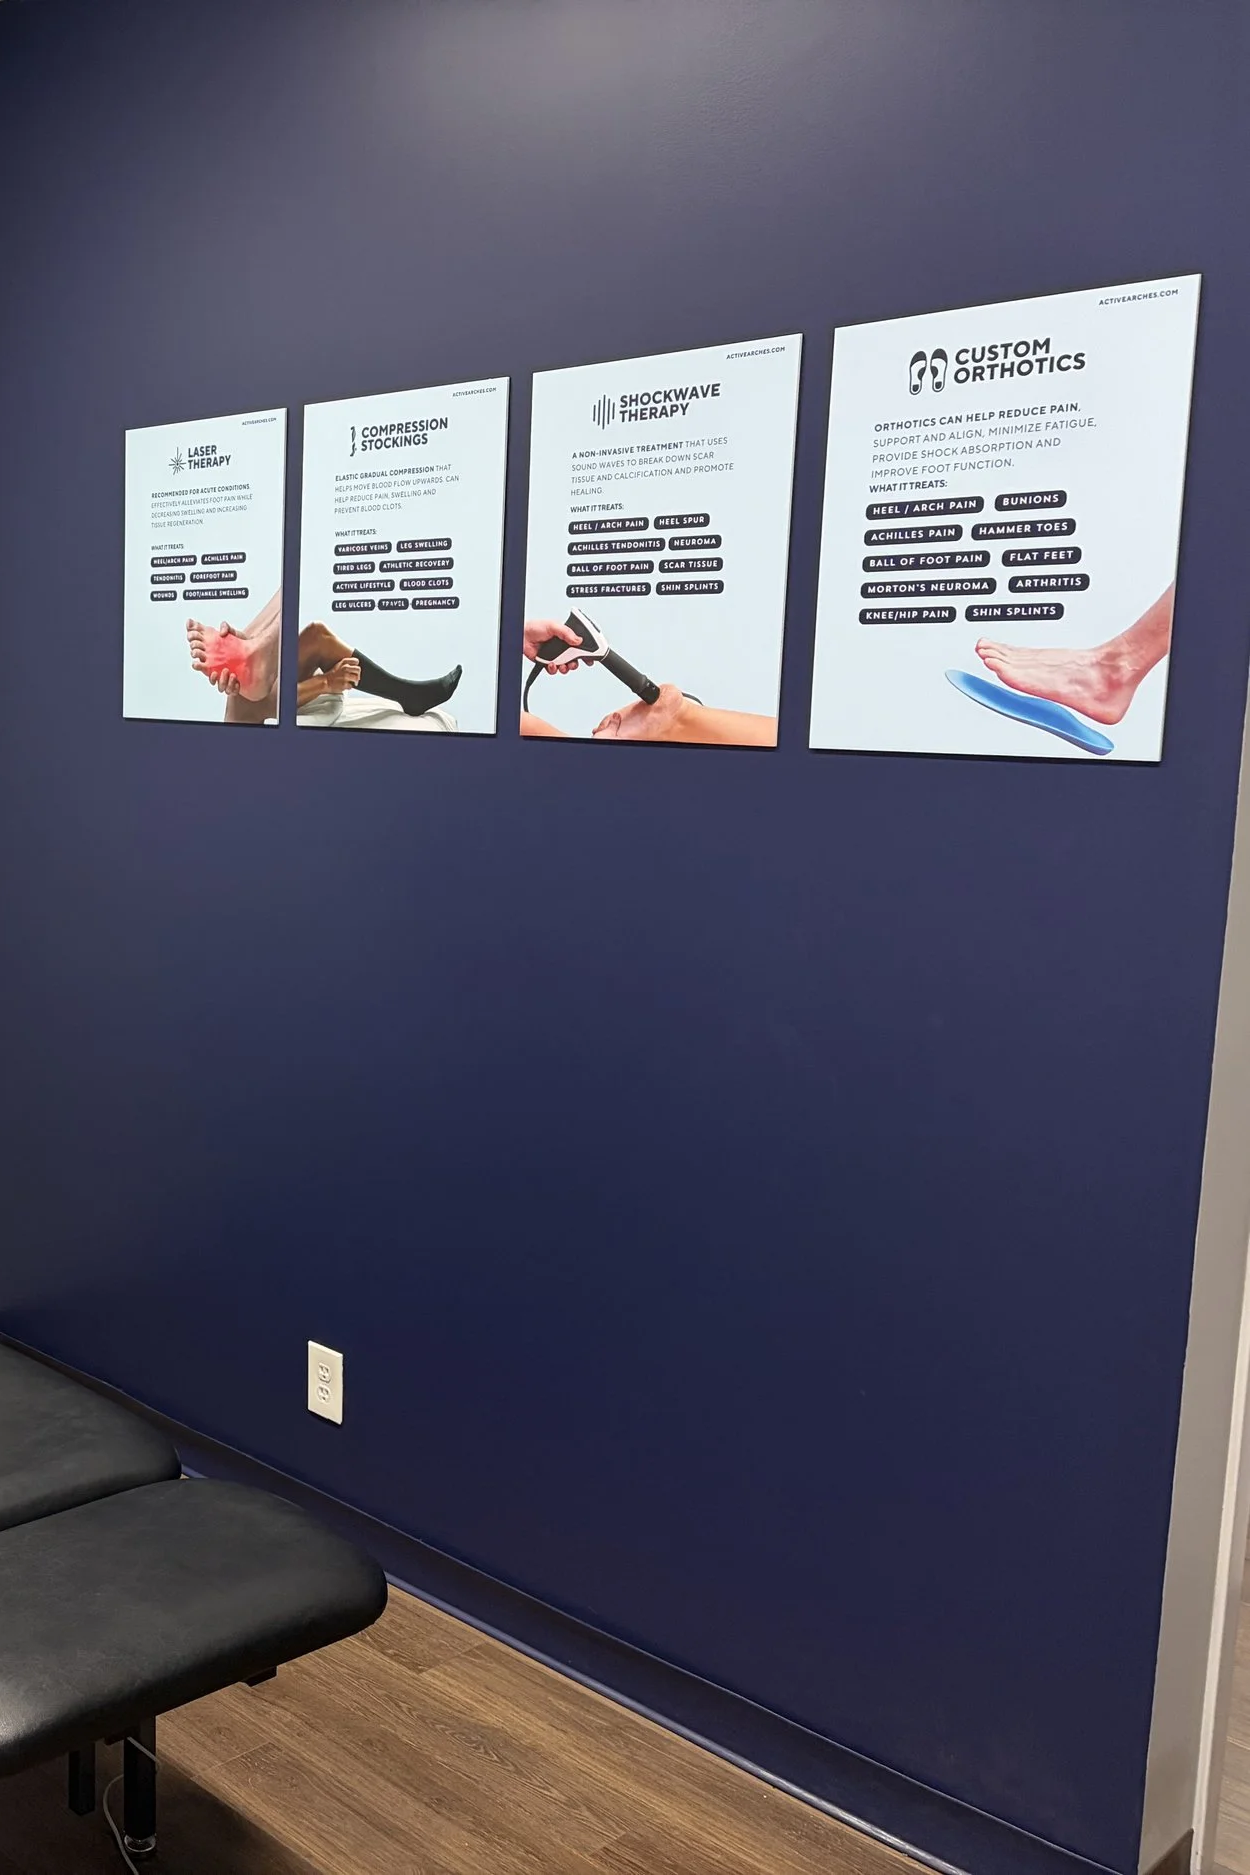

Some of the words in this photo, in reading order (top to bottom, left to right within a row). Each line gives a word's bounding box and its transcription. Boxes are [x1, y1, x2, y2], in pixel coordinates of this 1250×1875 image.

[1098, 289, 1179, 306] ACTIVEARCHES.COM
[726, 346, 786, 360] ACTIVEARCHES.COM
[955, 337, 1051, 366] CUSTOM
[953, 352, 1086, 384] ORTHOTICS
[452, 387, 497, 397] ACTIVEARCHES.COM
[619, 383, 721, 409] SHOCKWAVE
[619, 402, 690, 423] THERAPY
[874, 417, 936, 433] ORTHOTICS
[939, 414, 963, 426] CAN
[966, 411, 995, 424] HELP
[998, 406, 1047, 420] REDUCE
[361, 417, 448, 438] COMPRESSION
[873, 434, 921, 448] SUPPORT
[923, 432, 946, 443] AND
[948, 428, 986, 441] ALIGN,
[988, 423, 1042, 437] MINIMIZE
[1045, 418, 1097, 432] FATIGUE,
[361, 433, 428, 452] STOCKINGS
[572, 451, 577, 459] A
[579, 446, 634, 458] NON-INVASIVE
[636, 441, 683, 453] TREATMENT
[685, 439, 705, 448] THAT
[707, 437, 728, 446] USES
[188, 445, 217, 458] LASER
[872, 450, 918, 463] PROVIDE
[921, 446, 959, 459] SHOCK
[961, 440, 1033, 456] ABSORPTION
[1036, 438, 1061, 450] AND
[188, 455, 231, 470] THERAPY
[571, 462, 597, 471] SOUND
[599, 459, 625, 469] WAVES
[626, 458, 637, 467] TO
[638, 456, 664, 466] BREAK
[665, 453, 691, 463] DOWN
[693, 451, 714, 461] SCAR
[335, 473, 359, 482] ELASTIC
[360, 470, 388, 479] GRADUAL
[389, 466, 435, 476] COMPRESSION
[436, 464, 451, 472] THAT
[571, 474, 595, 484] TISSUE
[597, 473, 613, 482] AND
[614, 468, 673, 480] CALCIFICATION
[674, 466, 691, 475] AND
[694, 463, 734, 474] PROMOTE
[871, 465, 919, 478] IMPROVE
[921, 463, 951, 475] FOOT
[953, 458, 1014, 472] FUNCTION.
[335, 485, 353, 493] HELPS
[354, 483, 371, 491] MOVE
[372, 481, 392, 489] BLOOD
[393, 479, 411, 487] FLOW
[446, 475, 459, 483] CAN
[869, 483, 898, 493] WHAT
[899, 482, 908, 491] IT
[909, 480, 947, 491] TREATS:
[151, 489, 188, 498] RECOMMENDED
[335, 495, 350, 503] HELP
[350, 494, 373, 502] REDUCE
[391, 490, 422, 498] SWELLING
[1003, 494, 1059, 506] BUNIONS
[334, 506, 360, 514] PREVENT
[360, 504, 381, 512] BLOOD
[570, 505, 590, 513] WHAT
[597, 503, 624, 511] TREATS:
[873, 505, 901, 515] HEEL
[904, 504, 909, 513] /
[912, 502, 944, 513] ARCH
[949, 500, 977, 510] PAIN
[573, 523, 592, 531] HEEL
[600, 521, 622, 529] ARCH
[625, 520, 644, 528] PAIN
[659, 517, 680, 525] HEEL
[683, 516, 705, 524] SPUR
[871, 530, 924, 541] ACHILLES
[928, 528, 956, 538] PAIN
[979, 524, 1031, 535] HAMMER
[1036, 522, 1068, 532] TOES
[572, 543, 609, 552] ACHILLES
[611, 540, 660, 550] TENDONITIS
[674, 537, 716, 546] NEUROMA
[869, 558, 896, 567] BALL
[900, 557, 915, 566] OF
[919, 556, 951, 565] FOOT
[955, 554, 983, 564] PAIN
[1010, 552, 1038, 562] FLAT
[1043, 550, 1074, 560] FEET
[571, 565, 590, 573] BALL
[663, 561, 685, 569] SCAR
[688, 560, 718, 568] TISSUE
[601, 585, 646, 593] FRACTURES
[684, 583, 719, 591] SPLINTS
[868, 583, 926, 594] MORTON'S
[930, 581, 989, 592] NEUROMA
[1016, 577, 1082, 588] ARTHRITIS
[866, 610, 918, 620] KNEE/HIP
[922, 610, 949, 619] PAIN
[973, 608, 1001, 616] SHIN
[1006, 606, 1056, 616] SPLINTS
